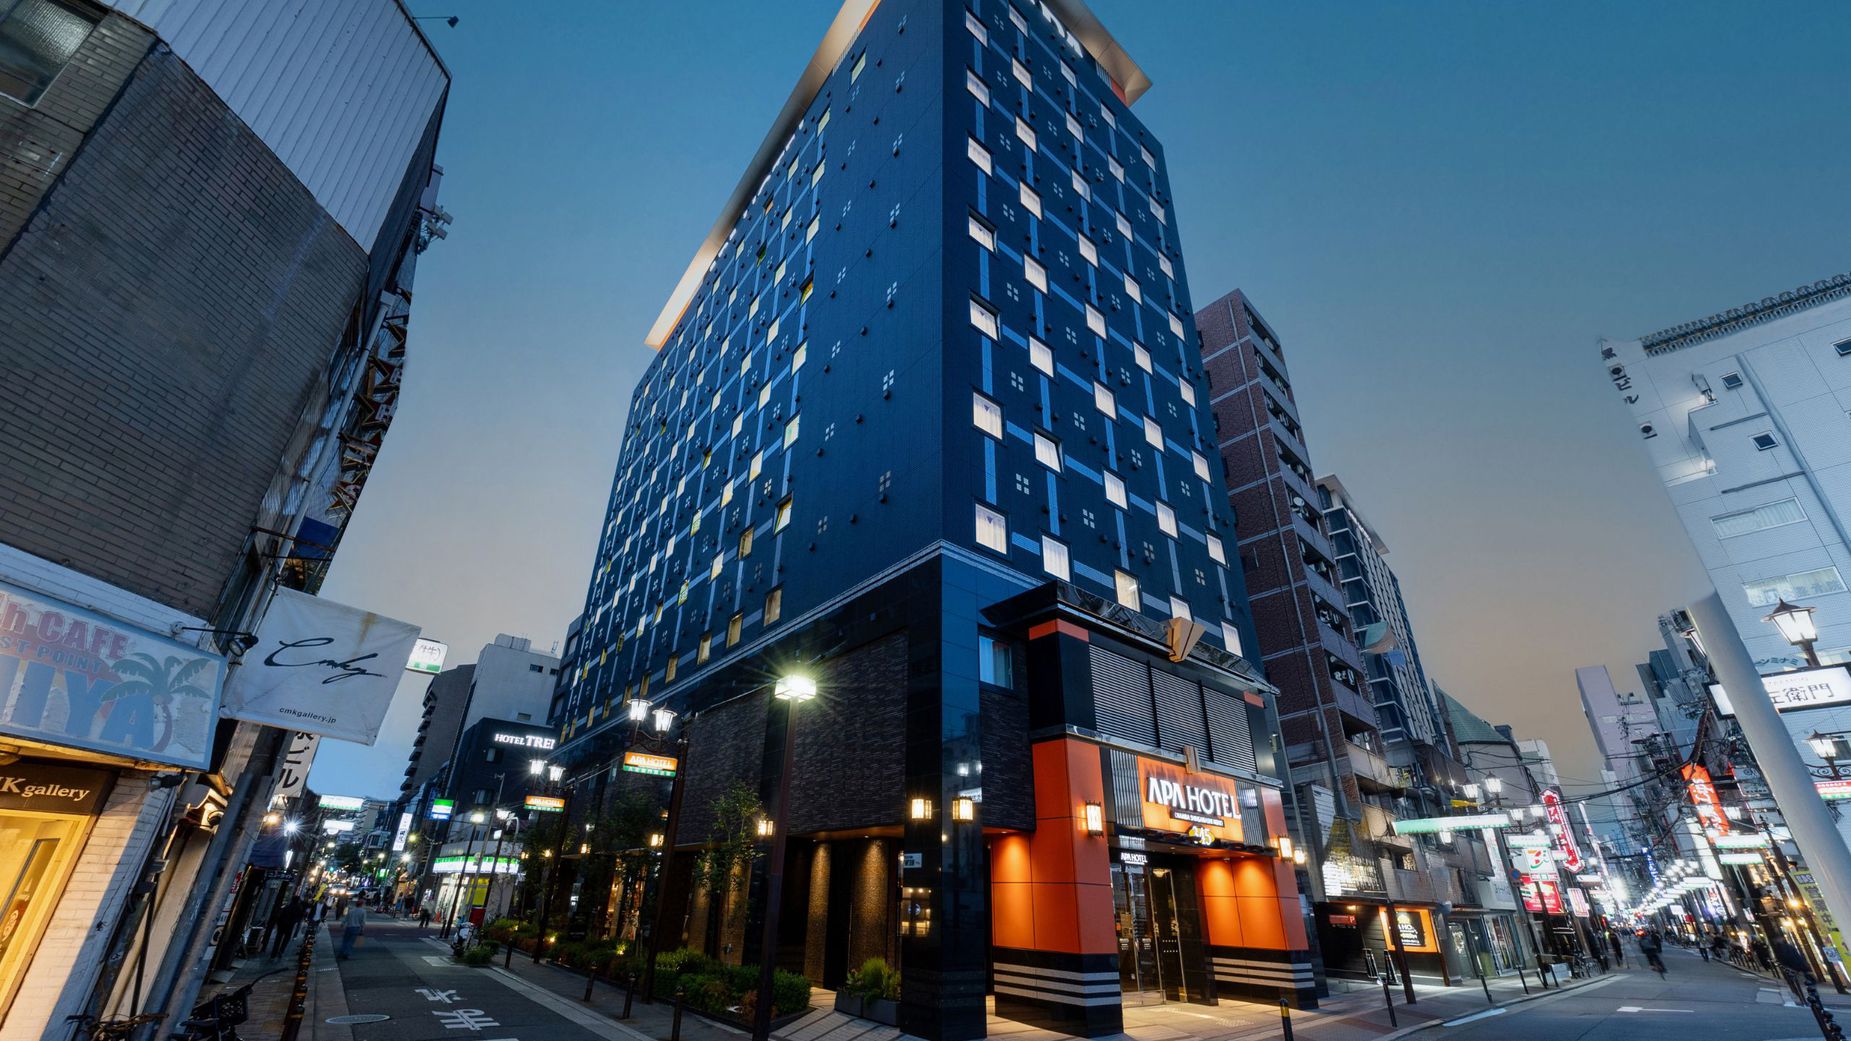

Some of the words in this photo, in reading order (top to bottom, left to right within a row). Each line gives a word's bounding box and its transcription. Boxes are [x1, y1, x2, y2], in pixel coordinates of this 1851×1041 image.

[37, 610, 129, 660] CAFE
[36, 643, 103, 674] POINT
[279, 706, 337, 724] cmkgallery.jp
[494, 733, 525, 746] HOTEL
[0, 776, 26, 793] K
[21, 784, 90, 802] gallery
[1148, 776, 1187, 810] APA
[1185, 785, 1242, 820] HOTEL
[1120, 852, 1132, 862] APA
[1131, 854, 1148, 863] HOTEL
